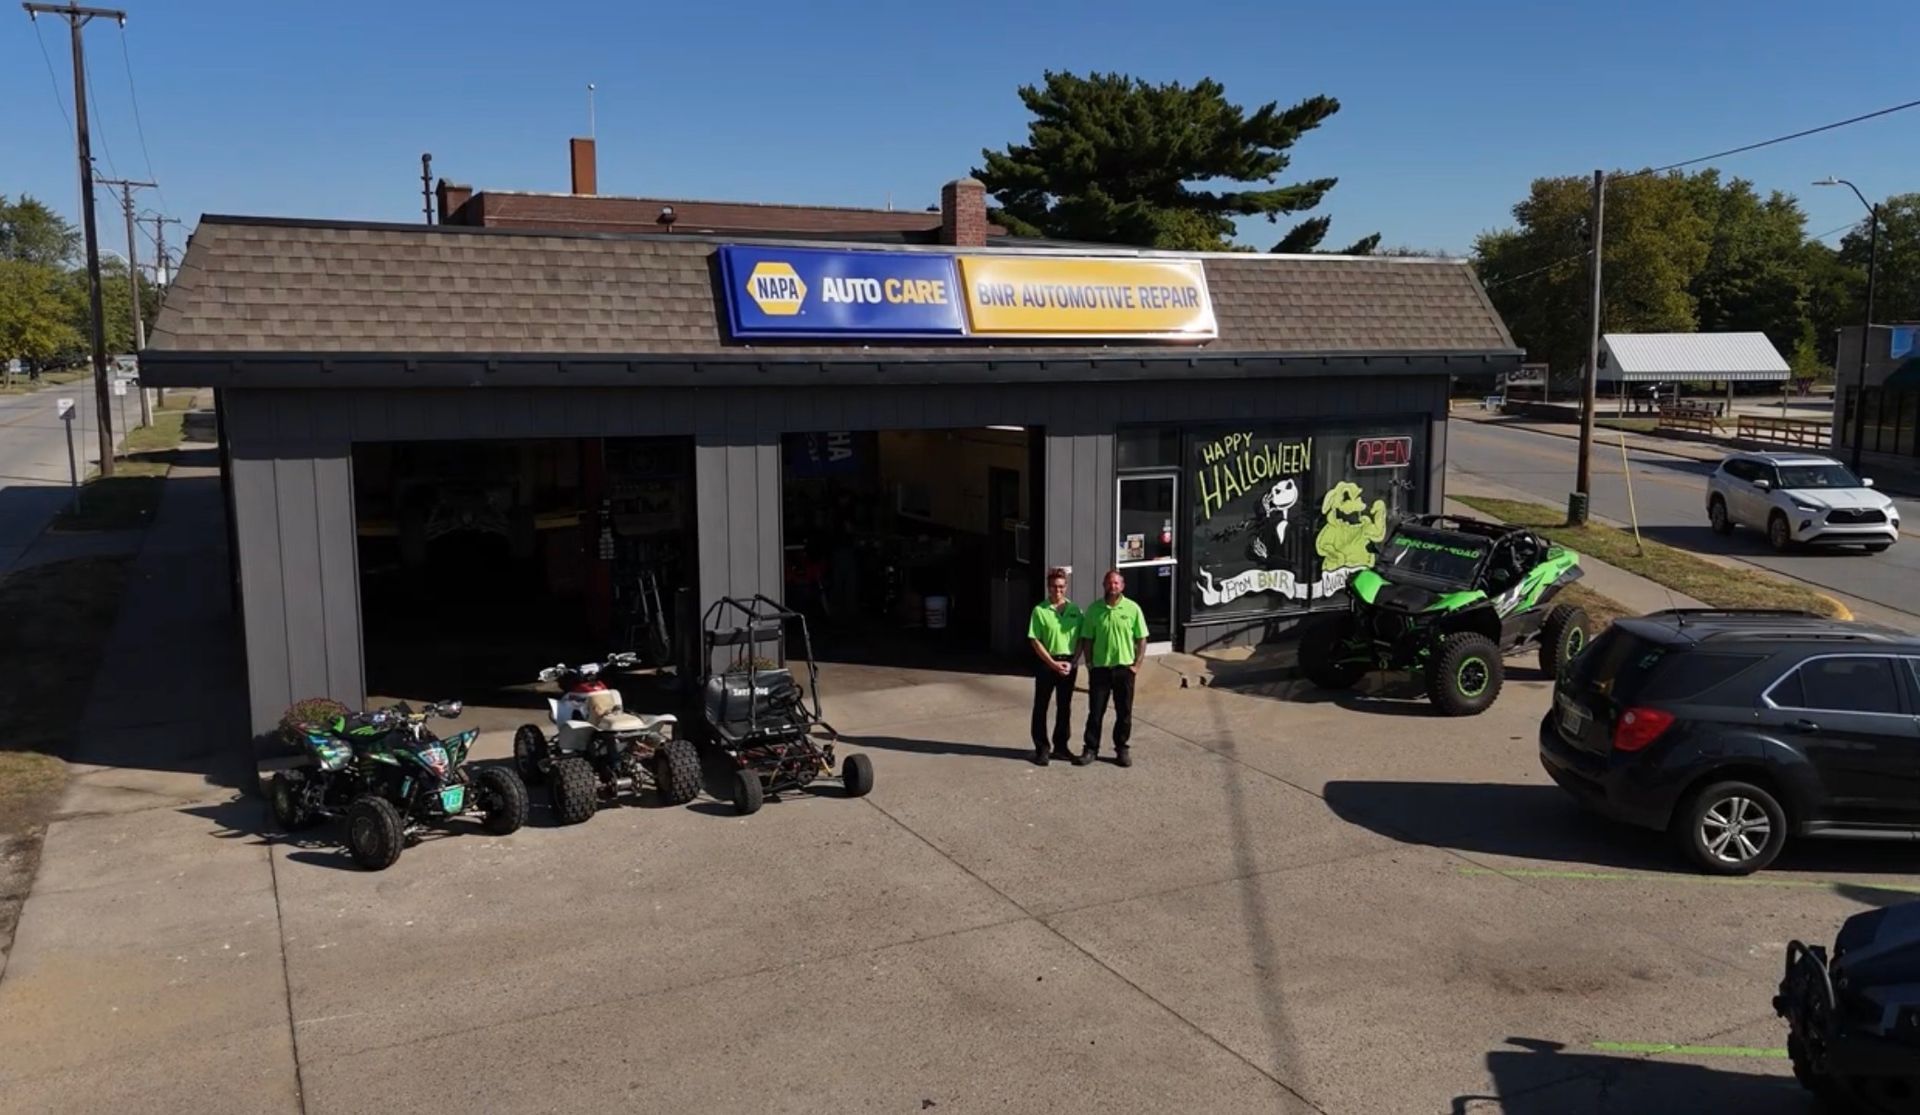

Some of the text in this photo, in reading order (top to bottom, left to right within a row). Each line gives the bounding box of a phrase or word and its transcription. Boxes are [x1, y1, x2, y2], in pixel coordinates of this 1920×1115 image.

[756, 277, 799, 299] NAPA
[822, 277, 948, 304] AUTO CARE
[977, 282, 1199, 309] BNR AUTOMOTIVE REPAIR
[1203, 432, 1253, 465] HAPPY
[1358, 440, 1409, 465] OPEN
[1199, 437, 1312, 519] HALLOWEEN
[1257, 571, 1289, 590] BNR
